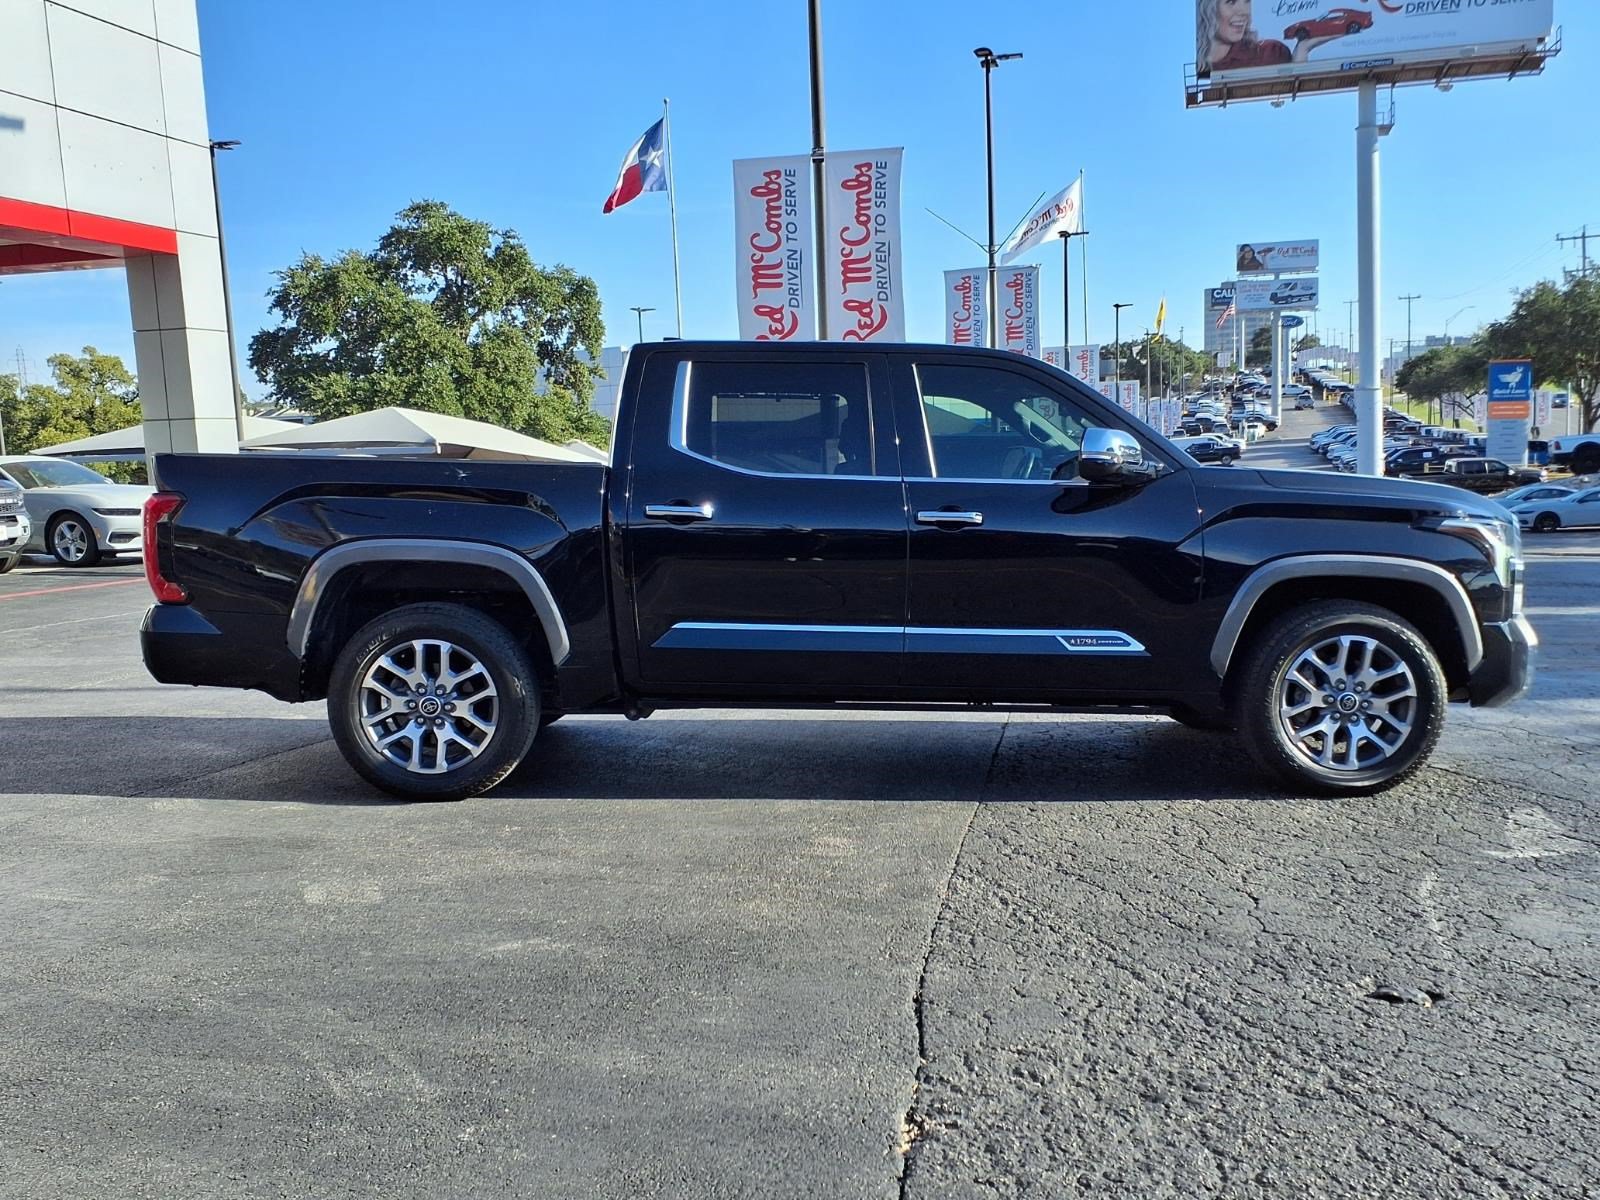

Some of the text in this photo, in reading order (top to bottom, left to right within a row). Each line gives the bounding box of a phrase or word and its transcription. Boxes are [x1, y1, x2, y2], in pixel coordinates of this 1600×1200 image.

[1405, 0, 1461, 14] DRIVEN
[750, 169, 784, 299] McCombs
[785, 168, 800, 308] DRIVEN TO SERVE
[840, 161, 873, 295] McCombs
[874, 160, 889, 302] DRIVEN TO SERVE
[953, 275, 972, 344] McCombs
[973, 274, 981, 346] RIVEN TO SERVE
[1005, 272, 1024, 346] McCombs
[1025, 271, 1034, 351] DRIVEN TO SERVE
[1076, 350, 1088, 380] Combs
